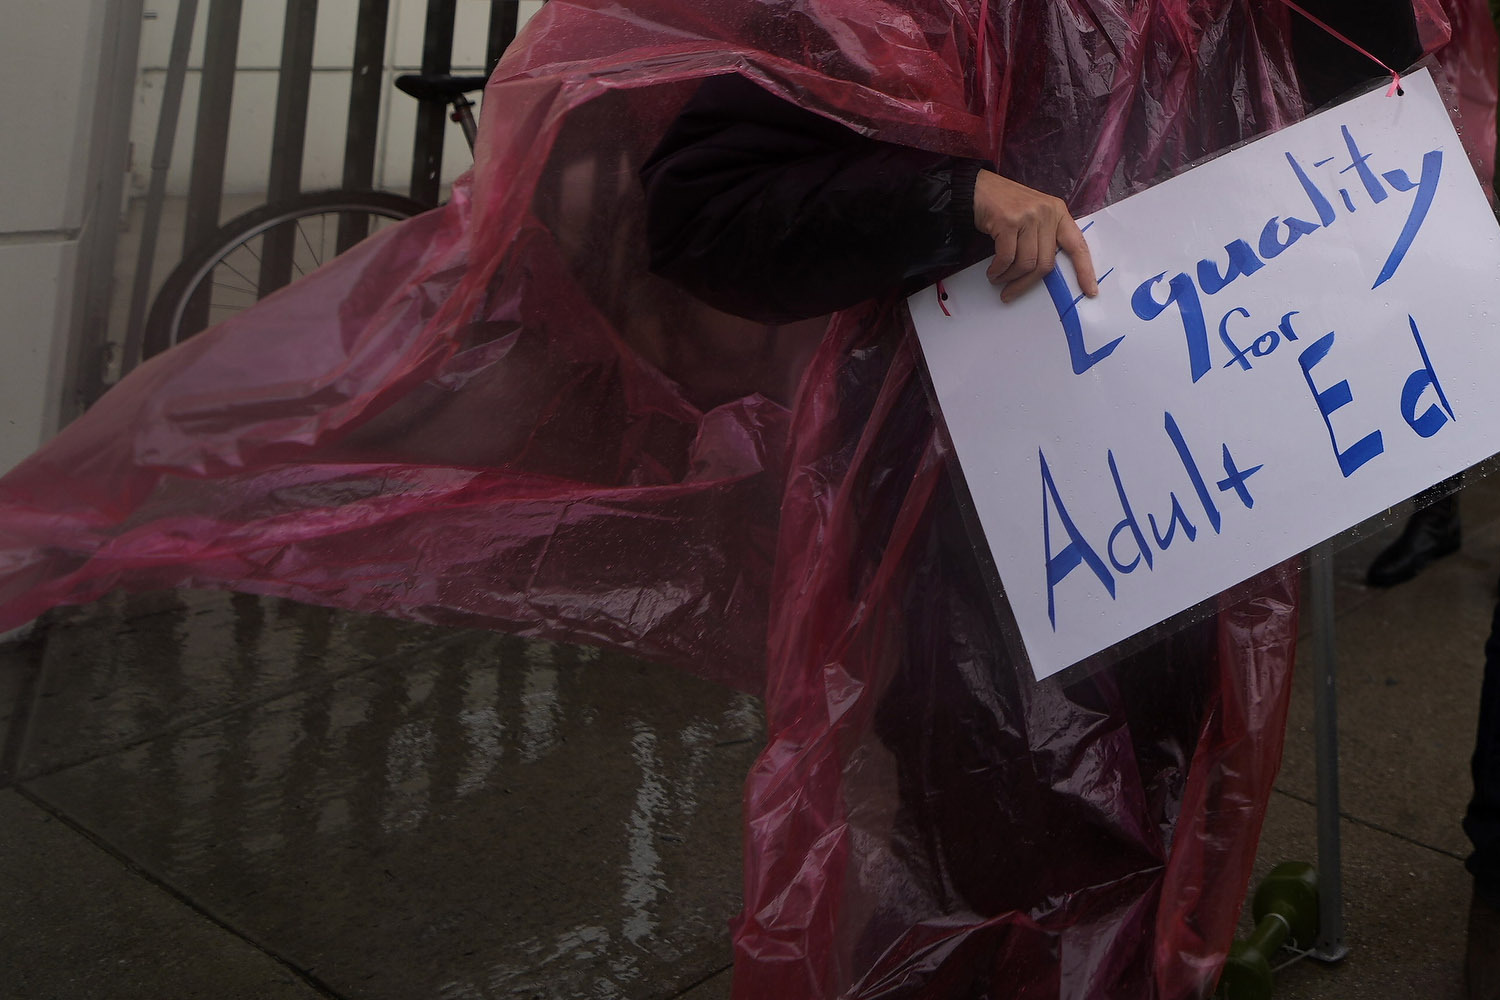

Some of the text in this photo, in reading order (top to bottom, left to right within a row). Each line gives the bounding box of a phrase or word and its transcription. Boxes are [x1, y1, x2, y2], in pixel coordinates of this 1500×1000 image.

[1042, 124, 1443, 384] Equality
[1217, 306, 1300, 371] for
[1038, 314, 1457, 633] Adult Ed
